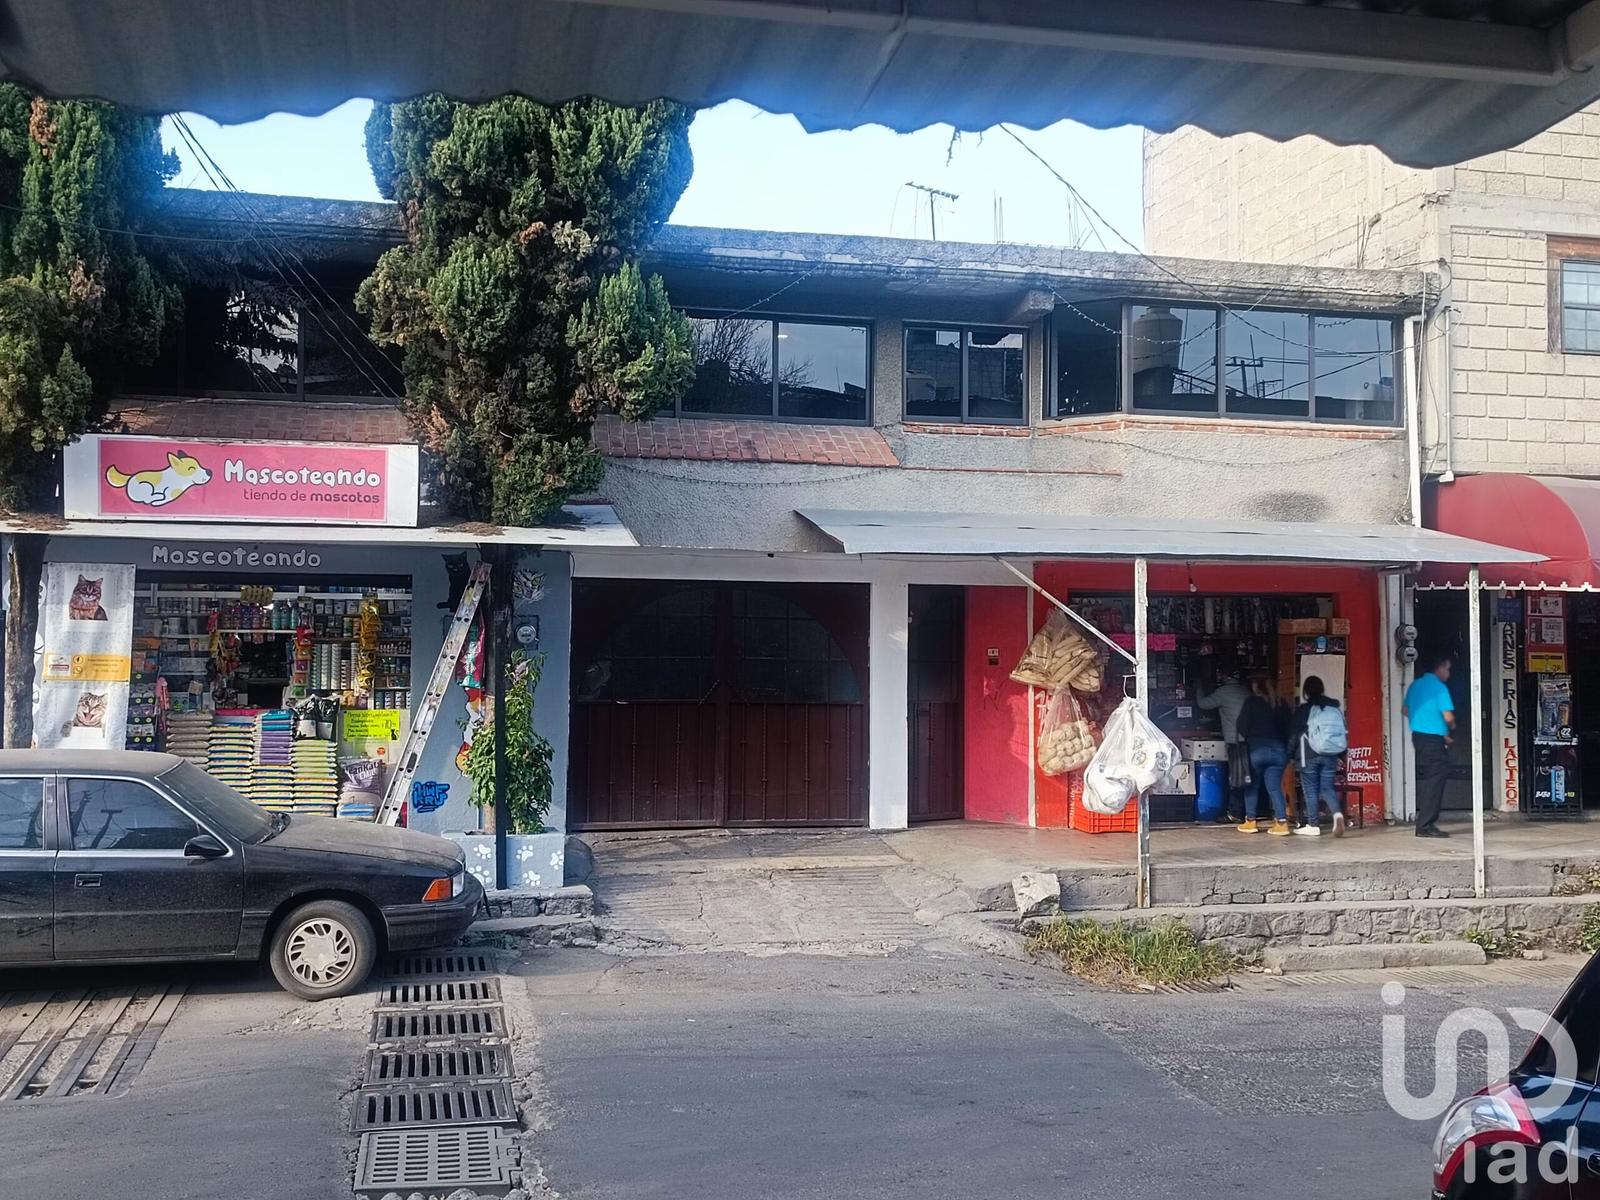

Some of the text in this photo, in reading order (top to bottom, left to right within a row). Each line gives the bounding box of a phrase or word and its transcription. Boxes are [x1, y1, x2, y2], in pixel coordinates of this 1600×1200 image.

[224, 458, 381, 488] Mascoteando
[243, 488, 380, 504] tienda de mascotas
[151, 545, 321, 567] Mascoteando
[1503, 622, 1516, 670] ARNES
[1502, 679, 1517, 729] FRIAS
